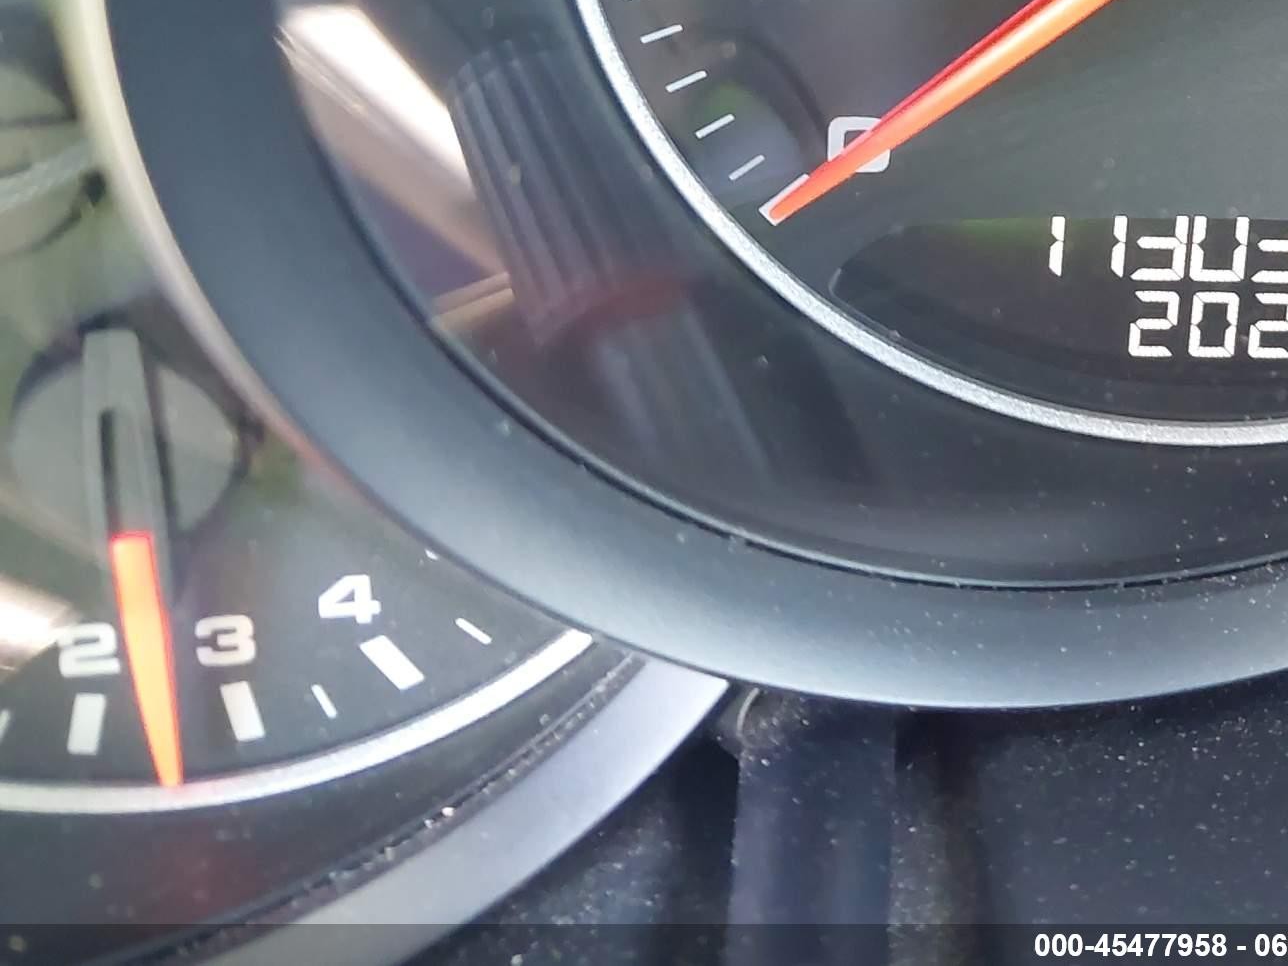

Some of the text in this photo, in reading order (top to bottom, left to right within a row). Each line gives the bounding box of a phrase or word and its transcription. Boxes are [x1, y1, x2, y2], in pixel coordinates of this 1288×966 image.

[317, 574, 382, 624] 4
[56, 622, 121, 678] 2
[194, 614, 257, 668] 3
